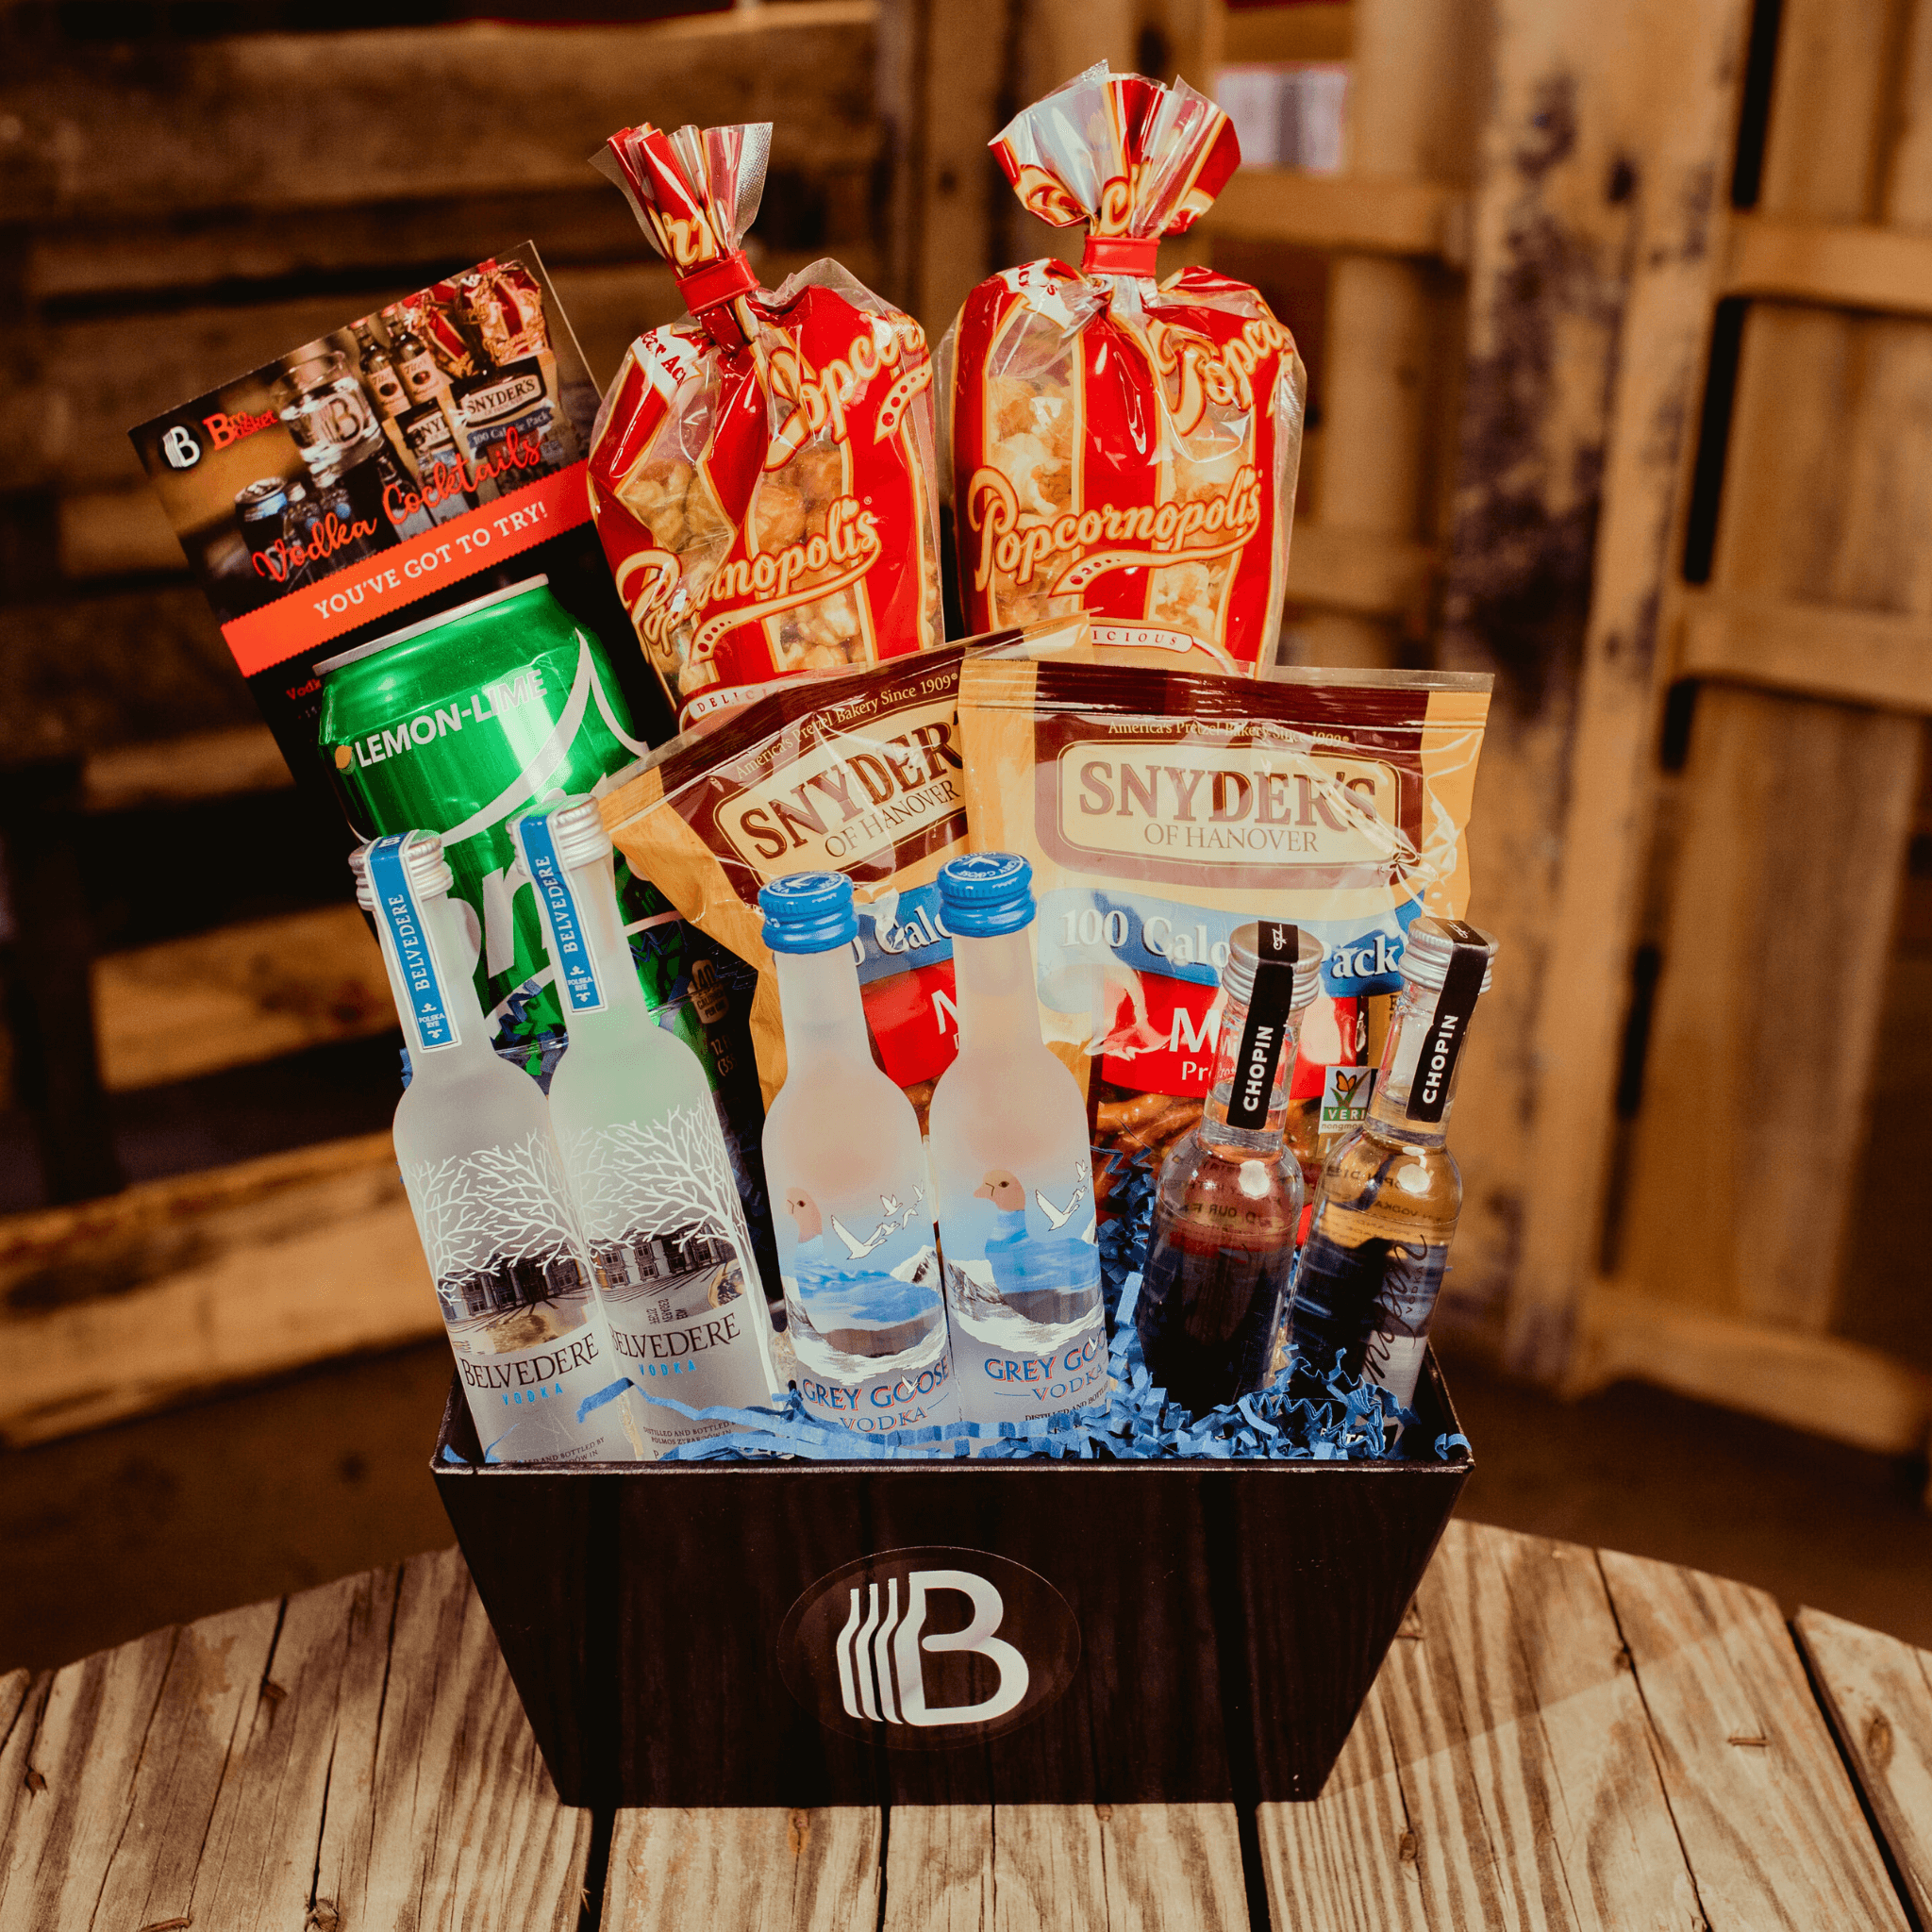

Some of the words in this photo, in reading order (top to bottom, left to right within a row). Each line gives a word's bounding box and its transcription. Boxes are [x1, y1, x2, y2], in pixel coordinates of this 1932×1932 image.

[469, 378, 535, 415] SNYDER'S
[252, 512, 377, 582] Vodka
[382, 425, 541, 525] Cocktails
[968, 464, 1261, 592] Popcornopolis
[313, 567, 401, 620] YOU'VE
[403, 546, 452, 579] GOT
[456, 527, 491, 555] TO
[493, 501, 550, 540] TRY!
[1091, 629, 1177, 646] ICIOUS
[354, 669, 548, 768] LEMON-LIME
[736, 735, 794, 780] America's
[793, 713, 834, 744] Pretzel
[837, 696, 879, 724] Bakery
[881, 686, 916, 704] Since
[1108, 721, 1173, 735] America's
[1176, 722, 1221, 736] Pretzel
[1225, 722, 1269, 739] Bakery
[1273, 724, 1305, 743] Since
[1078, 760, 1377, 832] SNYDER'S
[824, 824, 859, 858] OF
[859, 779, 961, 835] HANOVER
[1143, 822, 1179, 846] OF
[1184, 824, 1320, 853] HANOVER
[534, 855, 578, 955] BELVEDERE
[387, 893, 430, 991] BELVEDERE
[1057, 908, 1130, 949] 100
[567, 975, 593, 987] POLSKA
[418, 1012, 446, 1024] POLSKA
[425, 1019, 441, 1028] RYE
[1242, 1025, 1274, 1112] CHOPIN
[1422, 1014, 1459, 1104] CHOPIN
[1327, 1108, 1366, 1120] VERI
[1405, 1266, 1424, 1315] VODKA
[458, 1332, 600, 1390] BELVEDERE
[639, 1358, 696, 1376] VODKA
[984, 1356, 1057, 1383] GREY
[502, 1382, 564, 1406] VODKA
[803, 1377, 860, 1411] GREY
[870, 1358, 950, 1410] GOOSE
[674, 1427, 691, 1438] AND
[692, 1421, 730, 1436] BOTTLED
[839, 1405, 928, 1434] VODKA
[560, 1441, 596, 1459] BOTTLED
[651, 1436, 676, 1445] POLMOS
